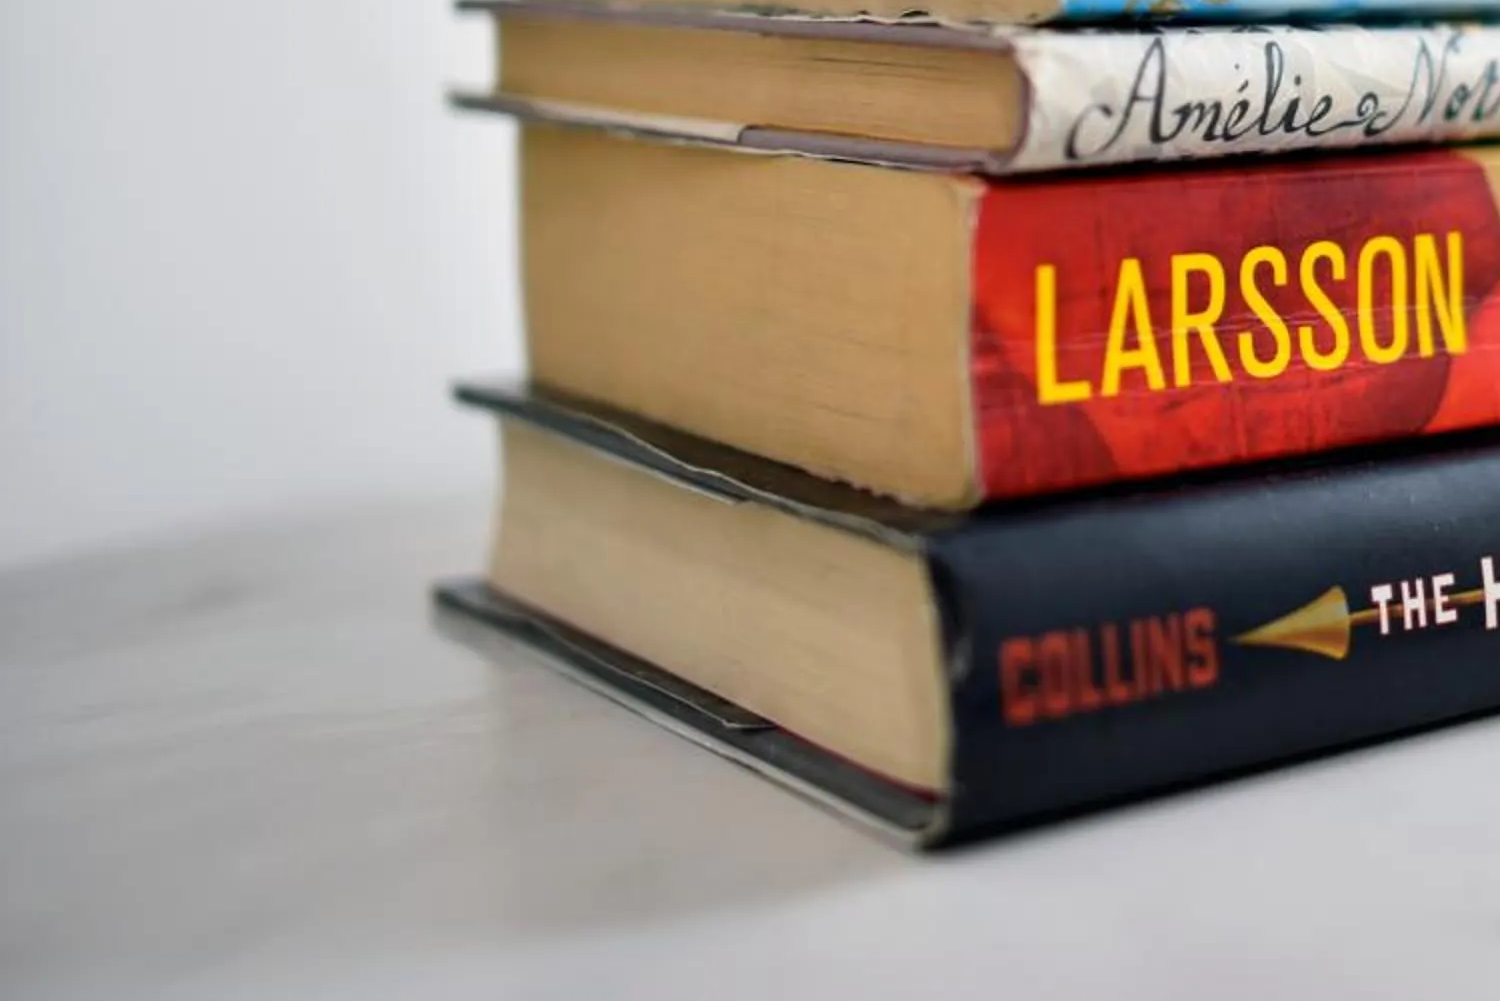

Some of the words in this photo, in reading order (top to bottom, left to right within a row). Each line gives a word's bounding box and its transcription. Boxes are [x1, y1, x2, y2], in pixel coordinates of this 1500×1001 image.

[1064, 33, 1376, 161] Amélie
[1035, 230, 1468, 406] LARSSON
[1000, 606, 1219, 727] COLLINS
[1371, 572, 1458, 636] THE
